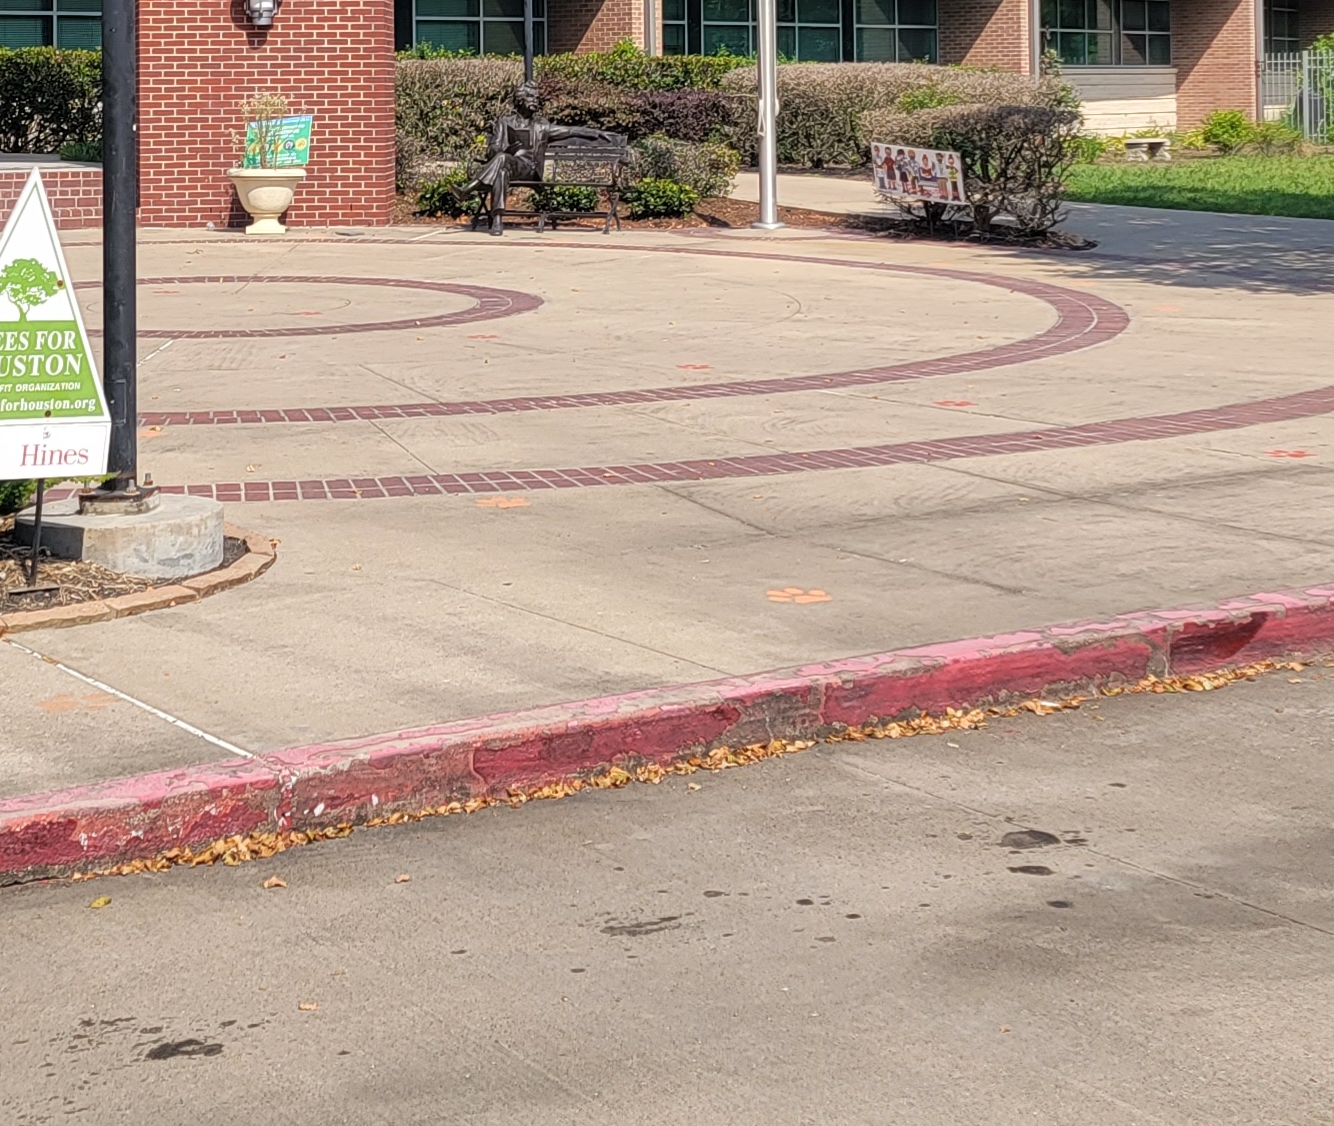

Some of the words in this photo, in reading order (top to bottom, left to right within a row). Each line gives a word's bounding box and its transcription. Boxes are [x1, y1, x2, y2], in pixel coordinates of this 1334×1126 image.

[35, 330, 77, 351] FOR
[16, 382, 81, 393] ORGANIZATION
[19, 443, 89, 467] Hines
